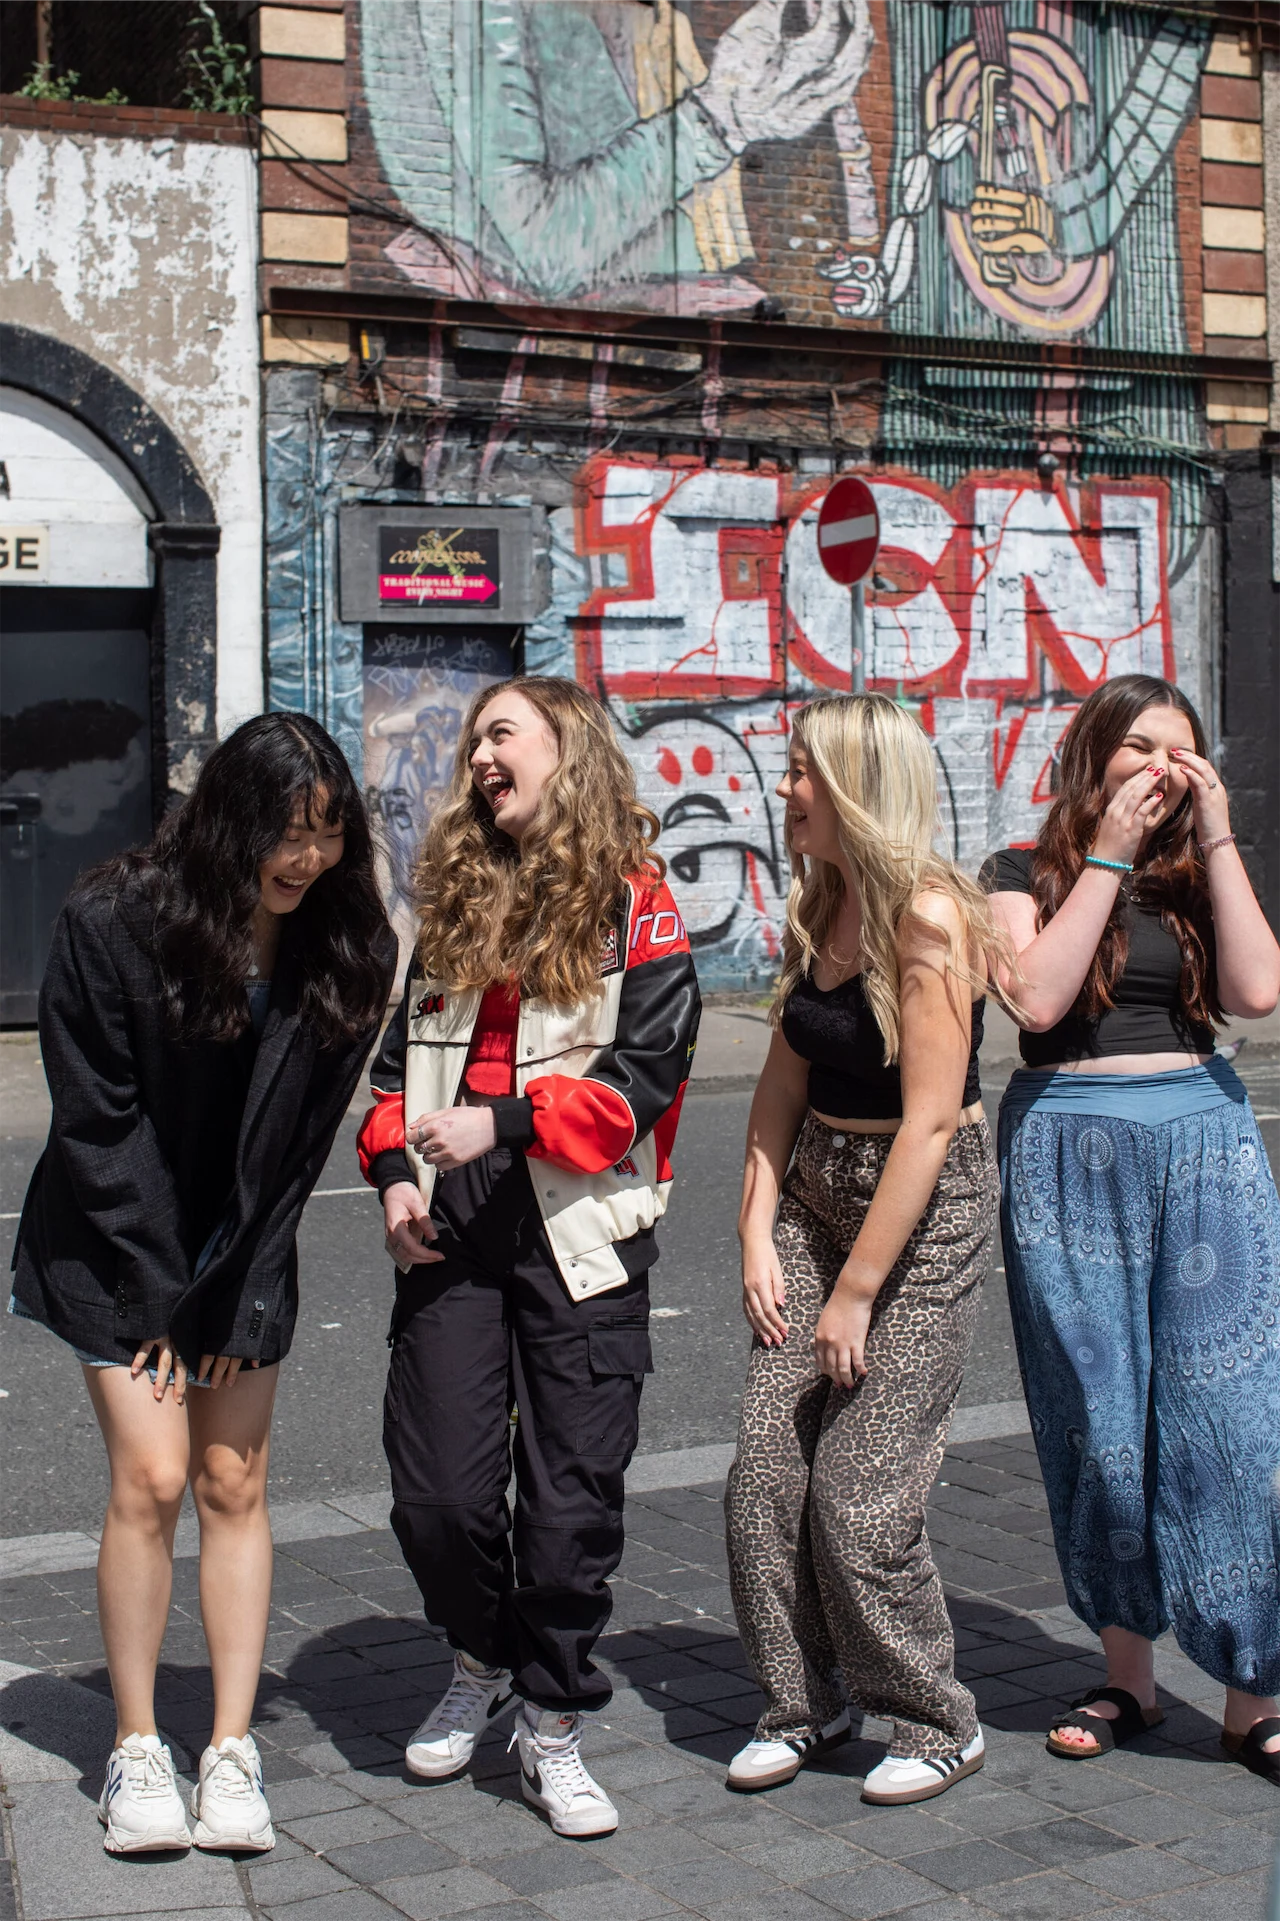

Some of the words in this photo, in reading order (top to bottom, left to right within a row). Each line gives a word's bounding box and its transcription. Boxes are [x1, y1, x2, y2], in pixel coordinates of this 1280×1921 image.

[383, 577, 451, 587] TRADITIONAL
[453, 578, 486, 588] MUSIC
[435, 588, 465, 597] NIGHT
